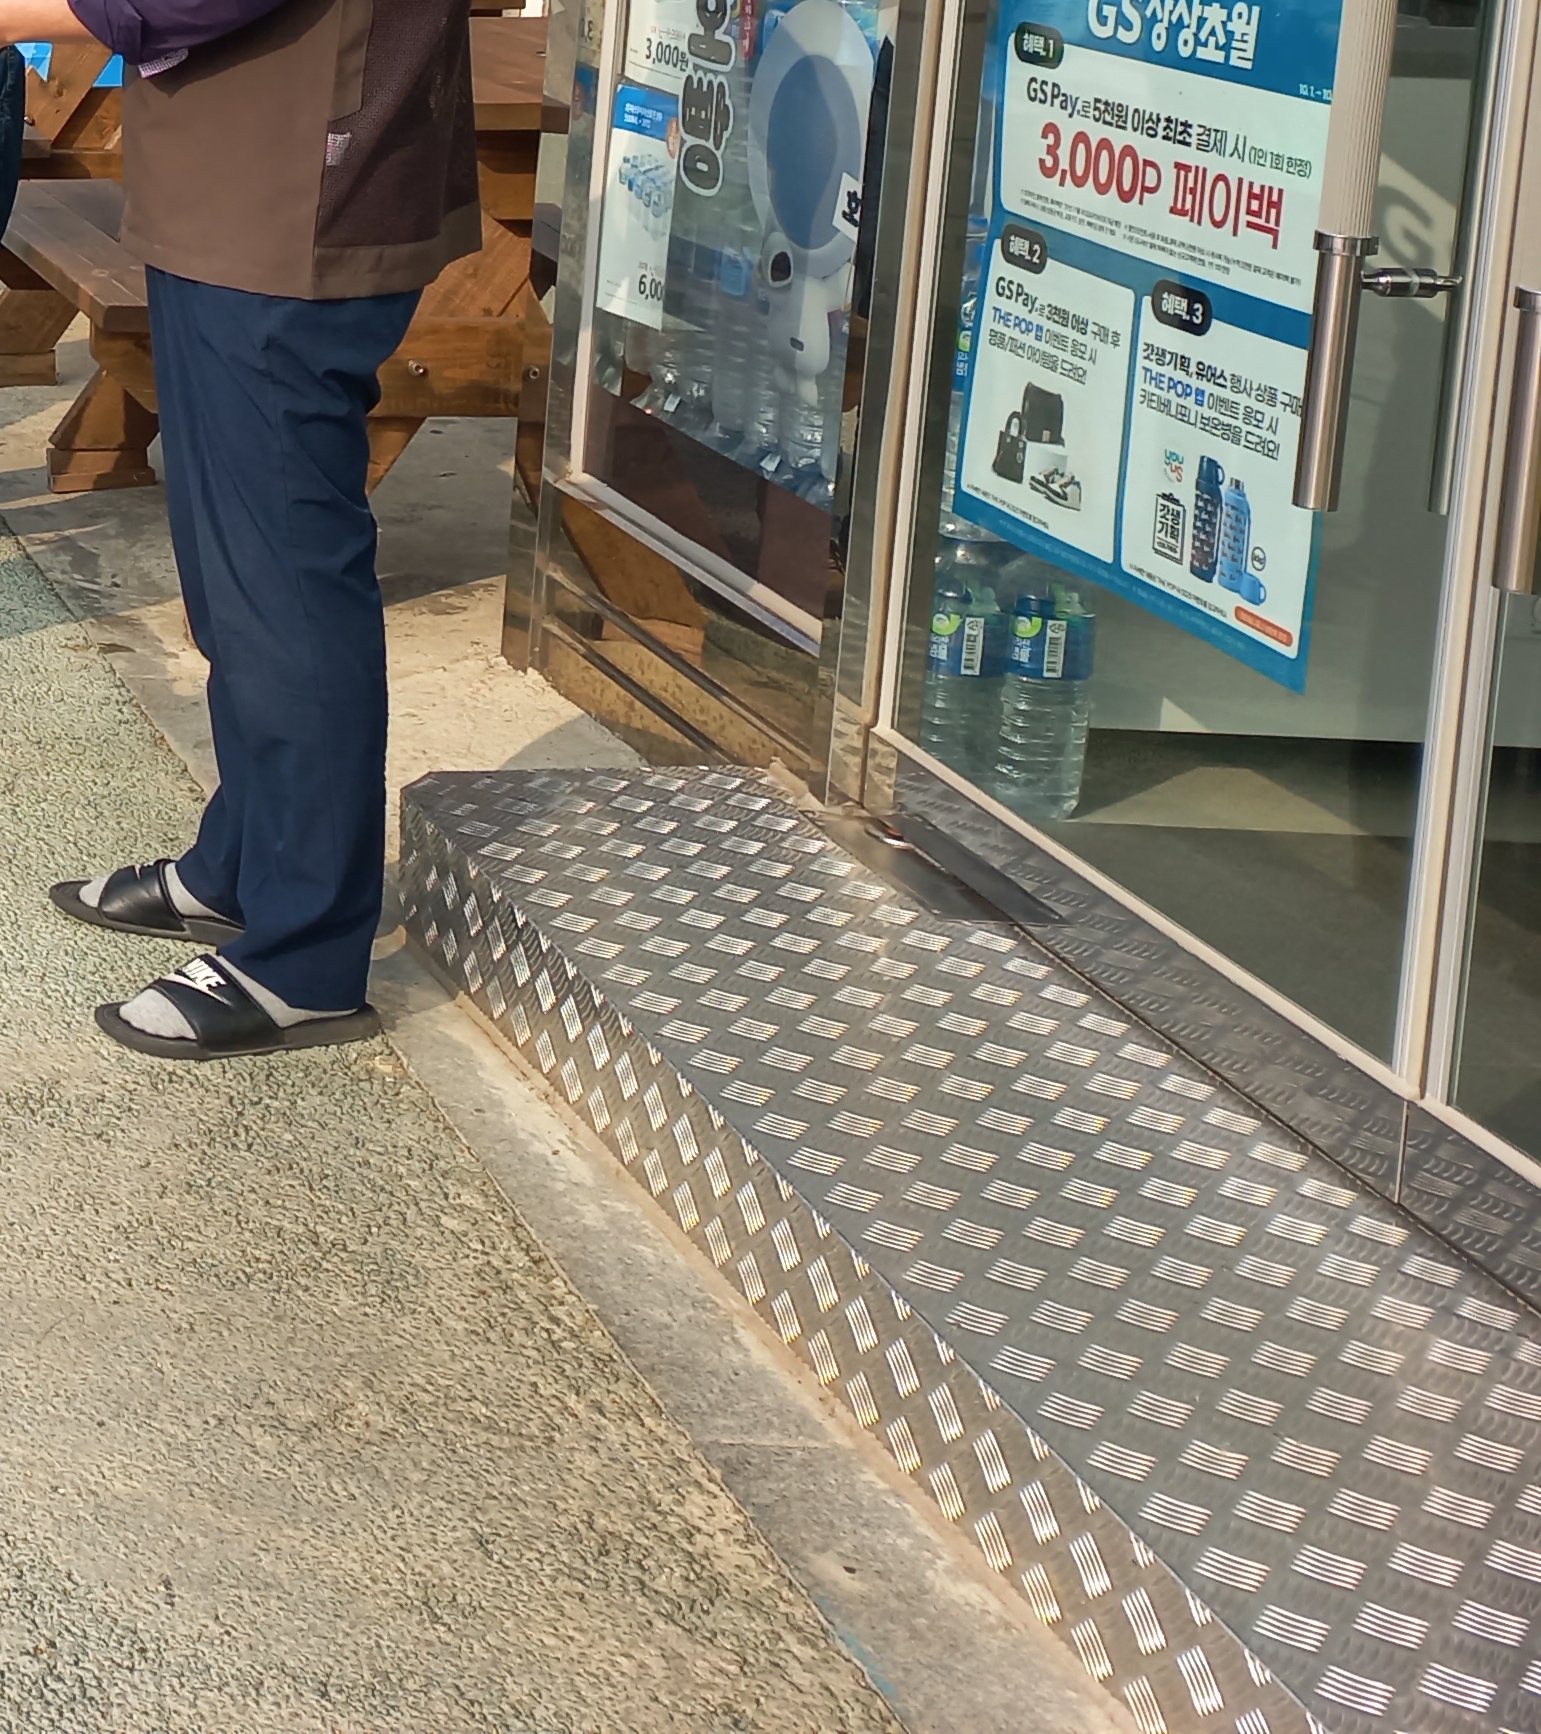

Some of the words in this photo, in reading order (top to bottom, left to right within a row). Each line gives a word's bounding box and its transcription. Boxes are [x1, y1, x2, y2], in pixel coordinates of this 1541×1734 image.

[643, 37, 689, 74] 3,000원
[1026, 76, 1049, 106] GS
[1092, 96, 1129, 131] 5천원
[1131, 107, 1159, 139] 이상
[1161, 115, 1193, 147] 최초
[1196, 122, 1228, 155] 결제
[1230, 134, 1247, 163] 시
[1038, 121, 1163, 206] 3,000P
[1169, 161, 1285, 250] 페이백
[992, 306, 1012, 329] THE
[1012, 314, 1034, 337] POP
[1088, 348, 1098, 366] 시
[995, 275, 1014, 301] GS
[1090, 321, 1110, 345] 구매
[1109, 329, 1122, 350] 후
[1141, 365, 1166, 392] THE
[1166, 376, 1193, 401] POP
[1206, 392, 1241, 421] 이벤트
[1242, 405, 1266, 430] 응모
[1266, 416, 1280, 437] 시
[1194, 360, 1228, 389] 유어스
[1229, 373, 1254, 398] 행사
[1254, 382, 1279, 408] 상품
[1198, 412, 1243, 447] 보온병을
